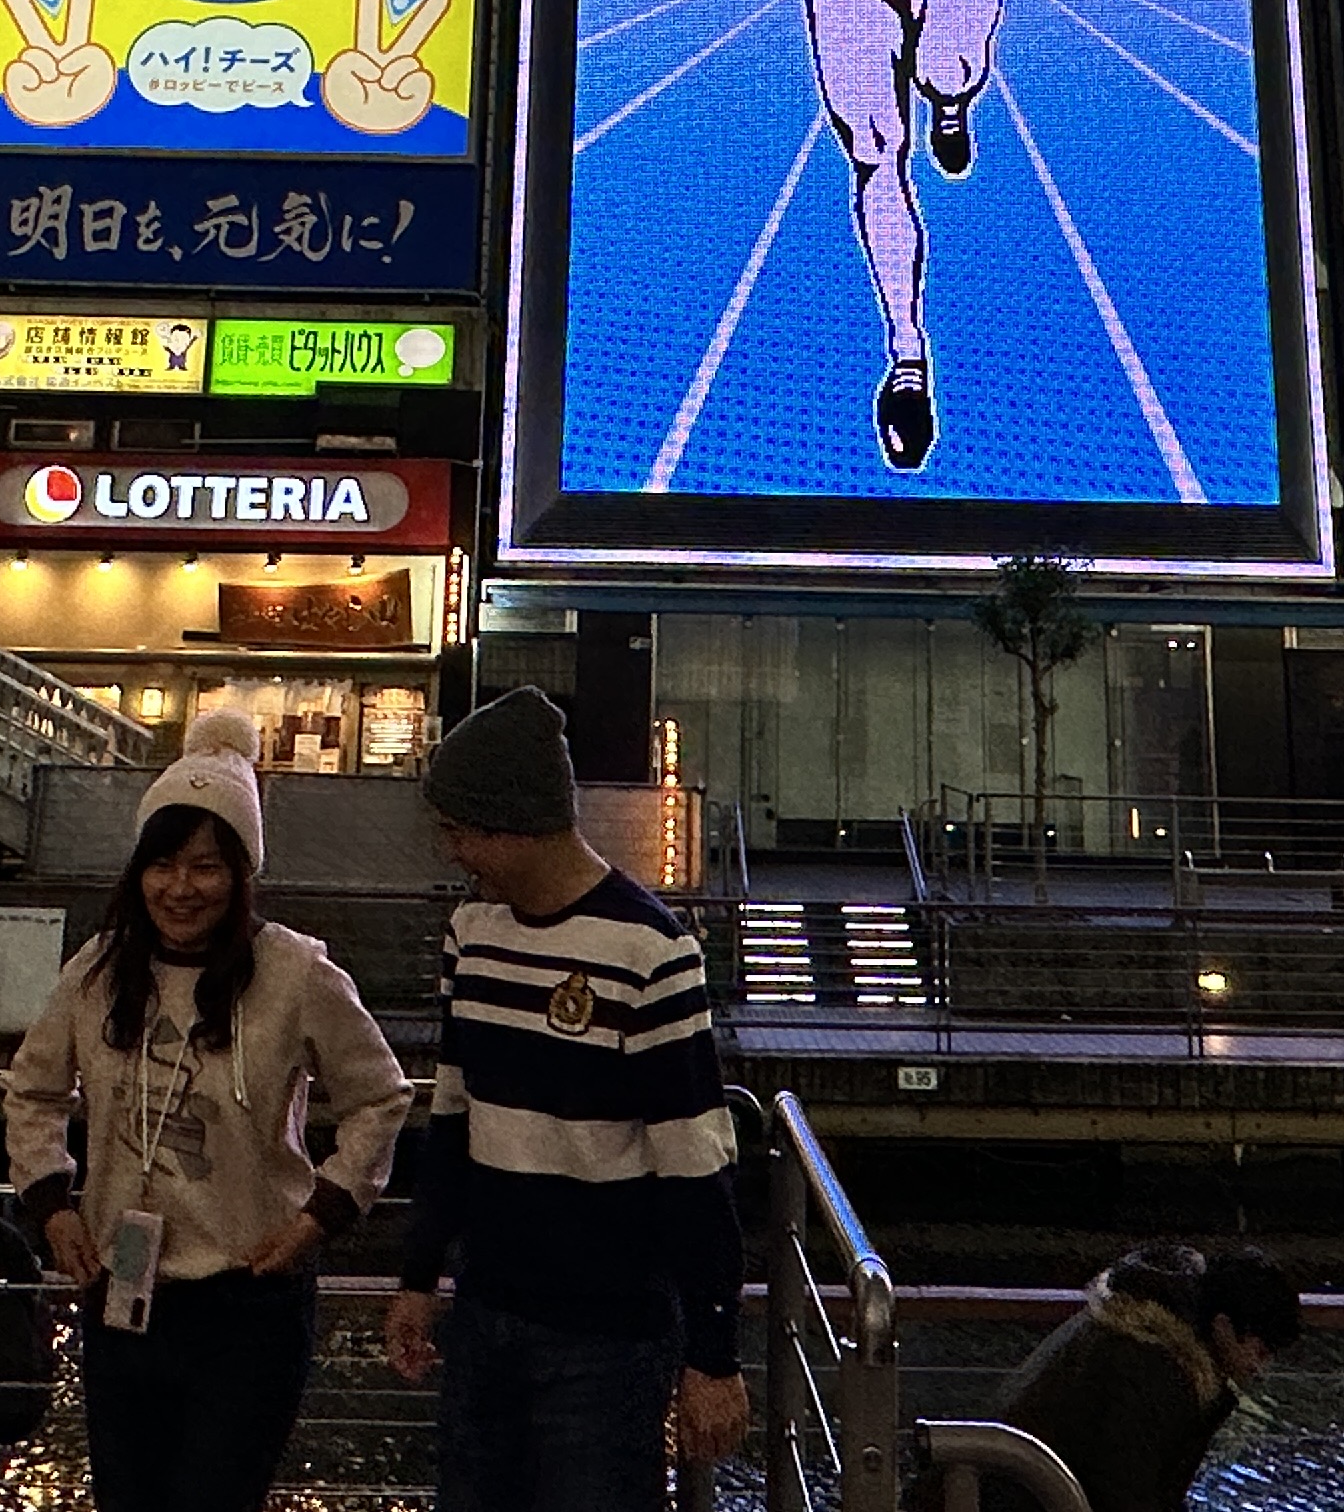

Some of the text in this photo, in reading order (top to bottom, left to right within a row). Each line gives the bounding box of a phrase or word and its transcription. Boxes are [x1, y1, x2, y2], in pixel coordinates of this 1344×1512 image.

[288, 327, 386, 375] ピタットハウス
[93, 472, 370, 523] LOTTERIA
